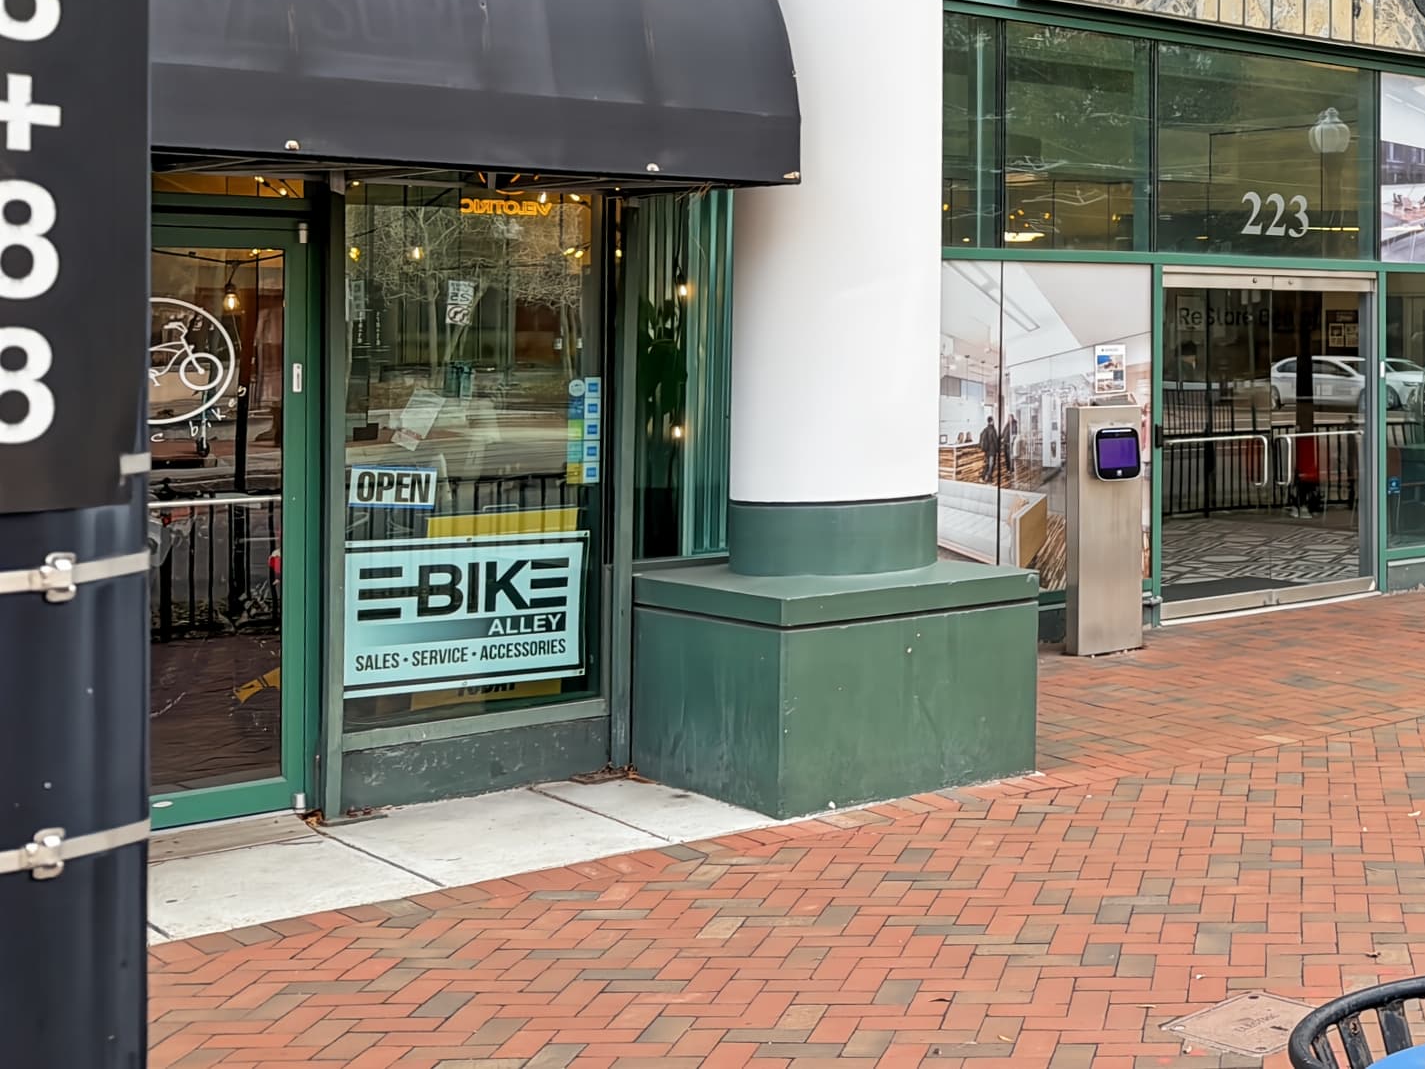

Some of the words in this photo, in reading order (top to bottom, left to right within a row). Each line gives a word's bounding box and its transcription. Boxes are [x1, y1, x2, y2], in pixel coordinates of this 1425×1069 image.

[1240, 191, 1309, 238] 223
[356, 471, 432, 504] OPEN
[488, 613, 563, 636] ALLEY
[355, 652, 400, 672] SALES
[412, 647, 469, 667] SERVICE
[480, 638, 567, 661] ACCESSORIES
